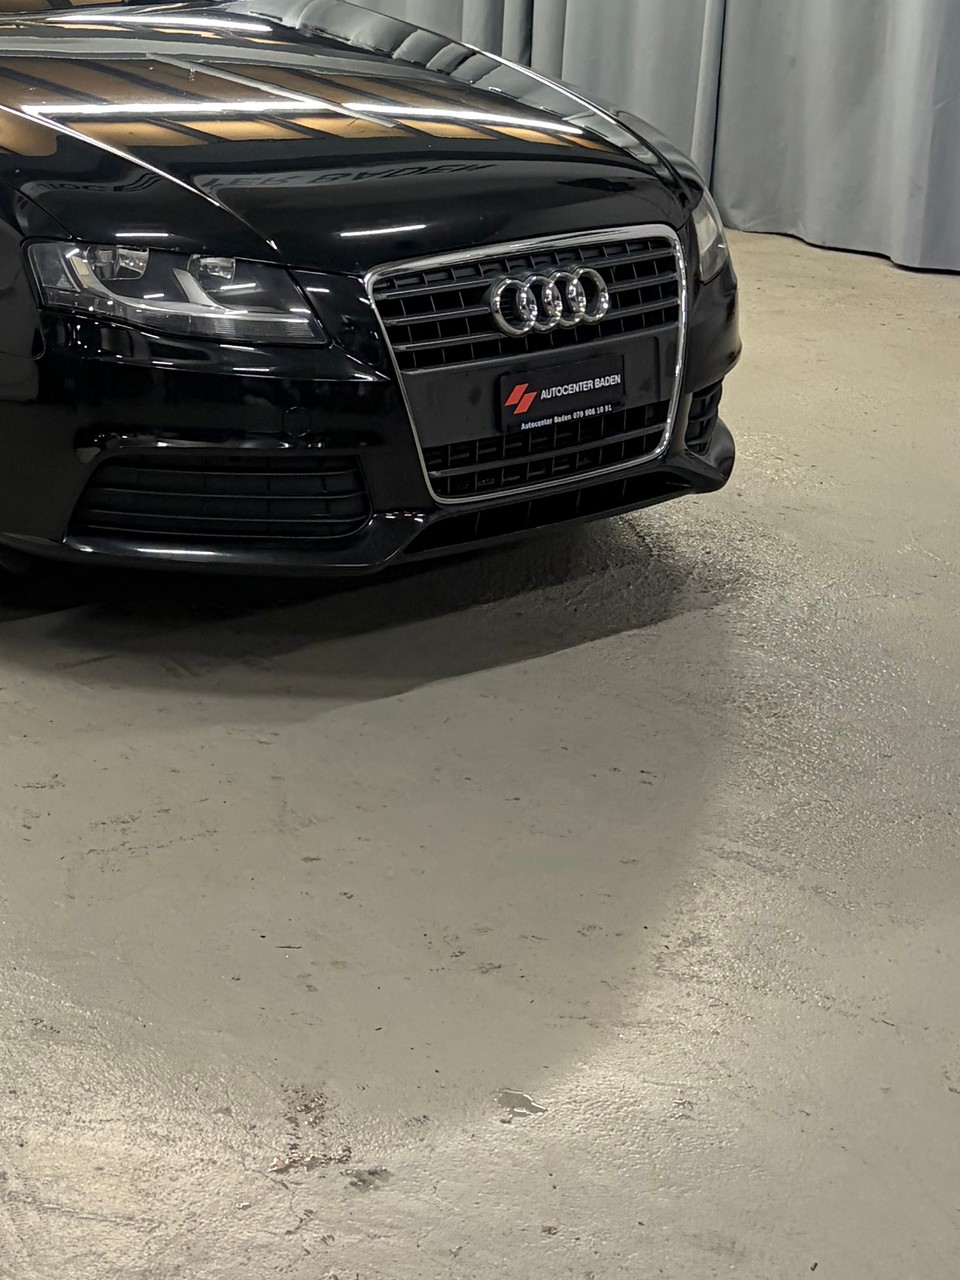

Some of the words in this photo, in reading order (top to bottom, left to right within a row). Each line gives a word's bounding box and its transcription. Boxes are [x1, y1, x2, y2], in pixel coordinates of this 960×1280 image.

[541, 379, 593, 399] AUTOCENTER
[594, 374, 621, 389] BADEN
[521, 418, 552, 430] Autocenter
[554, 414, 571, 423] Baden
[573, 411, 583, 419] 079
